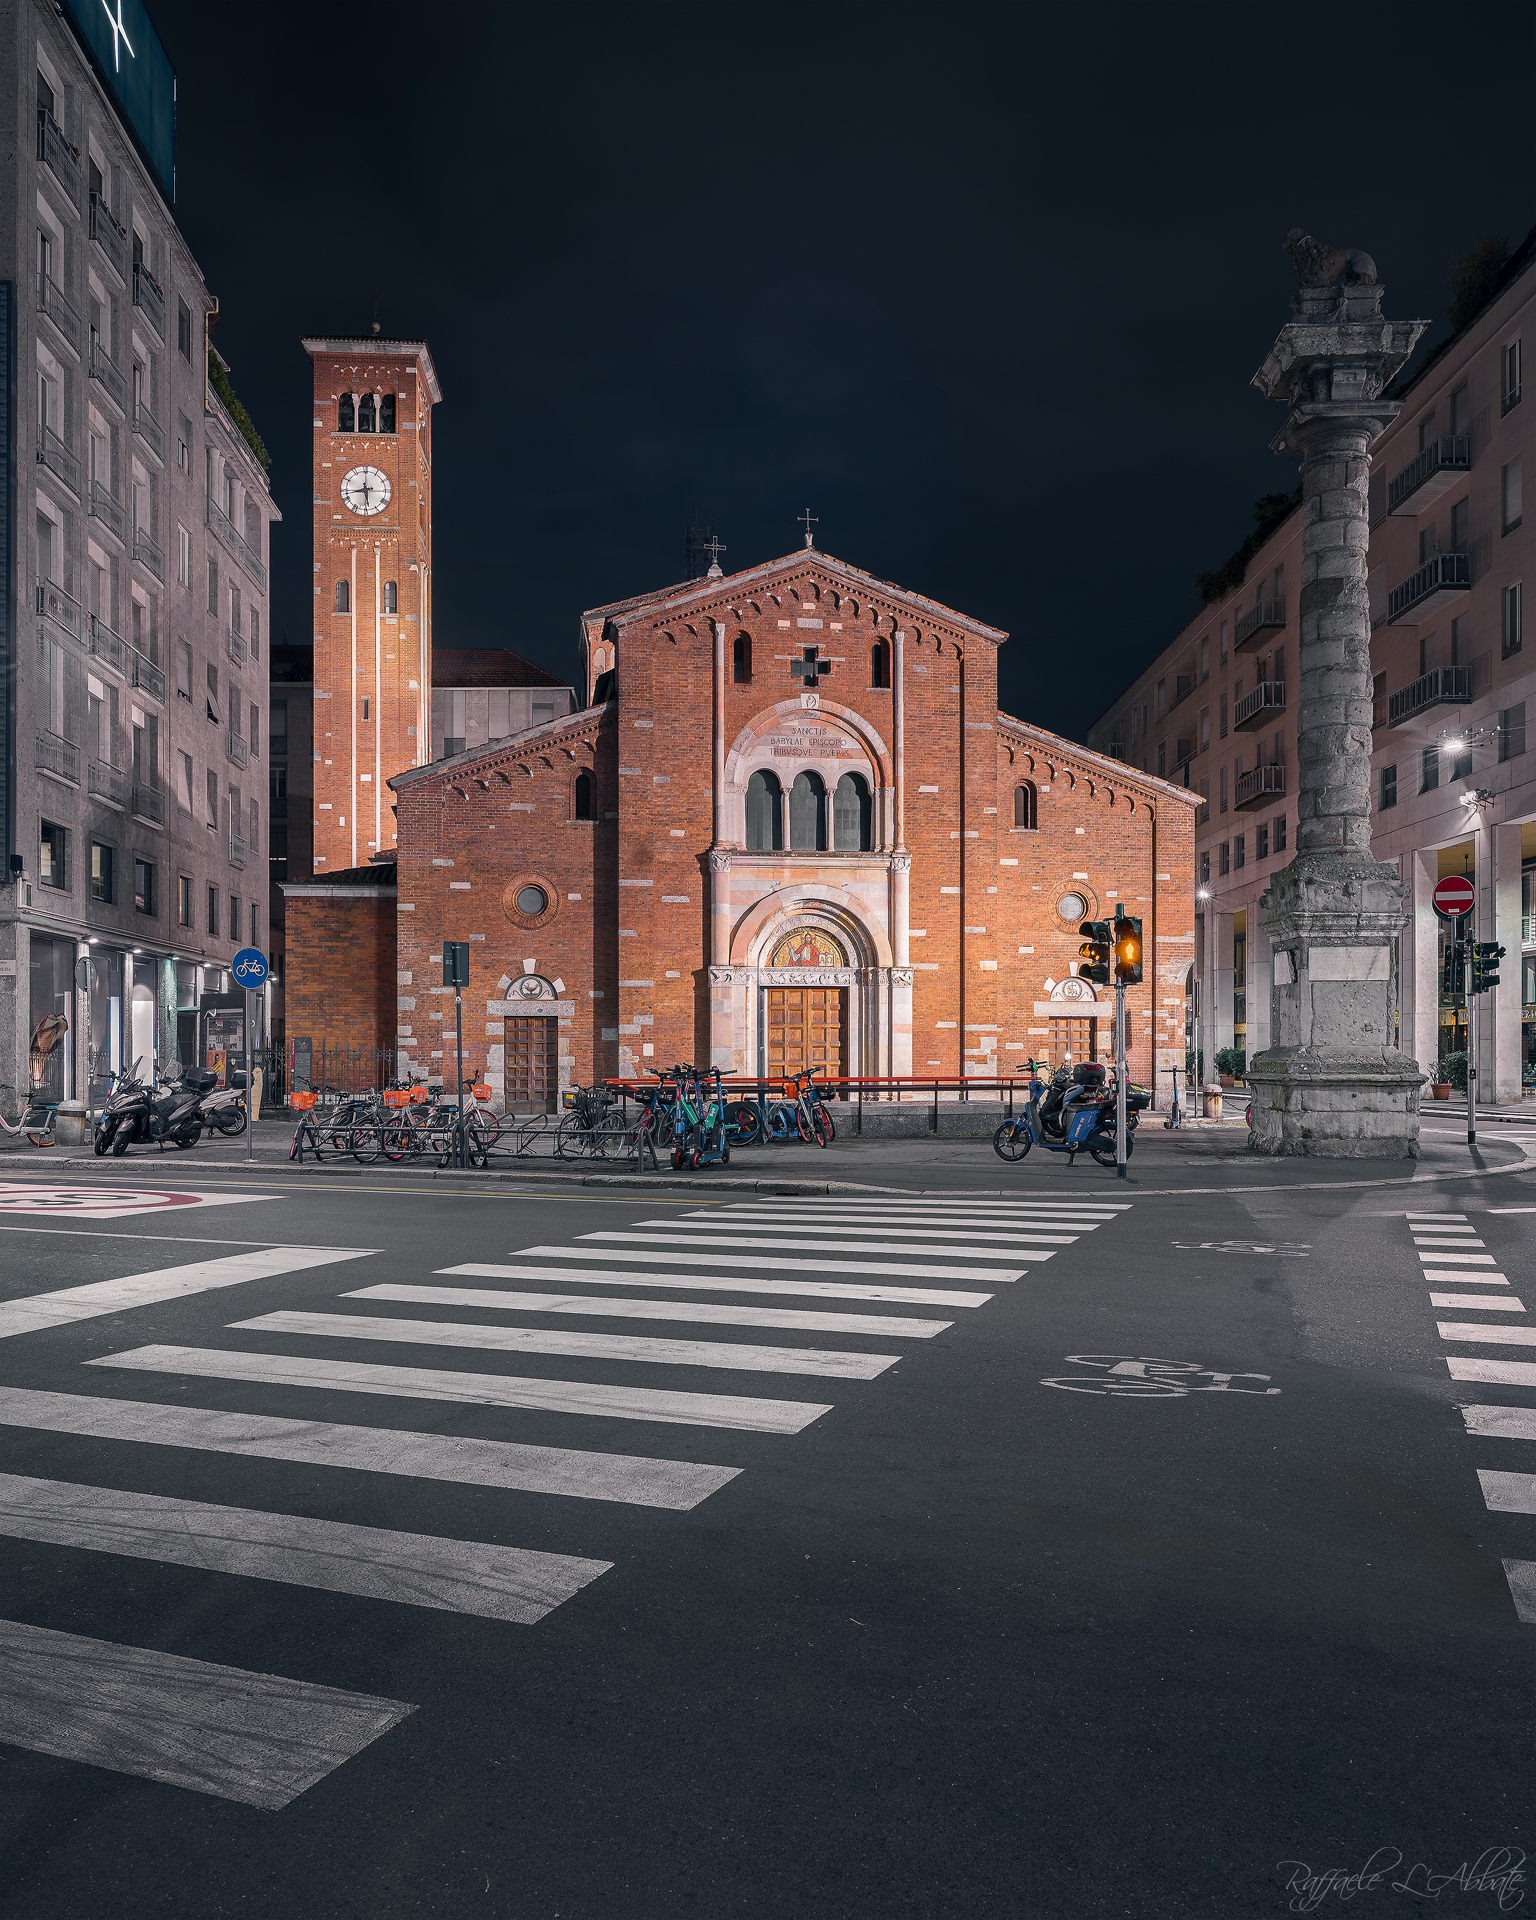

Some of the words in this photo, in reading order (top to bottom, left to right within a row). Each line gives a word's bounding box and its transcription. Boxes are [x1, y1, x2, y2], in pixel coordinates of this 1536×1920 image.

[791, 727, 827, 736] SANCTIS
[770, 737, 804, 746] BABYLAE
[808, 738, 847, 746] EPISCOPO
[769, 748, 812, 756] TRIBVSQVE
[820, 749, 849, 757] PVERIS
